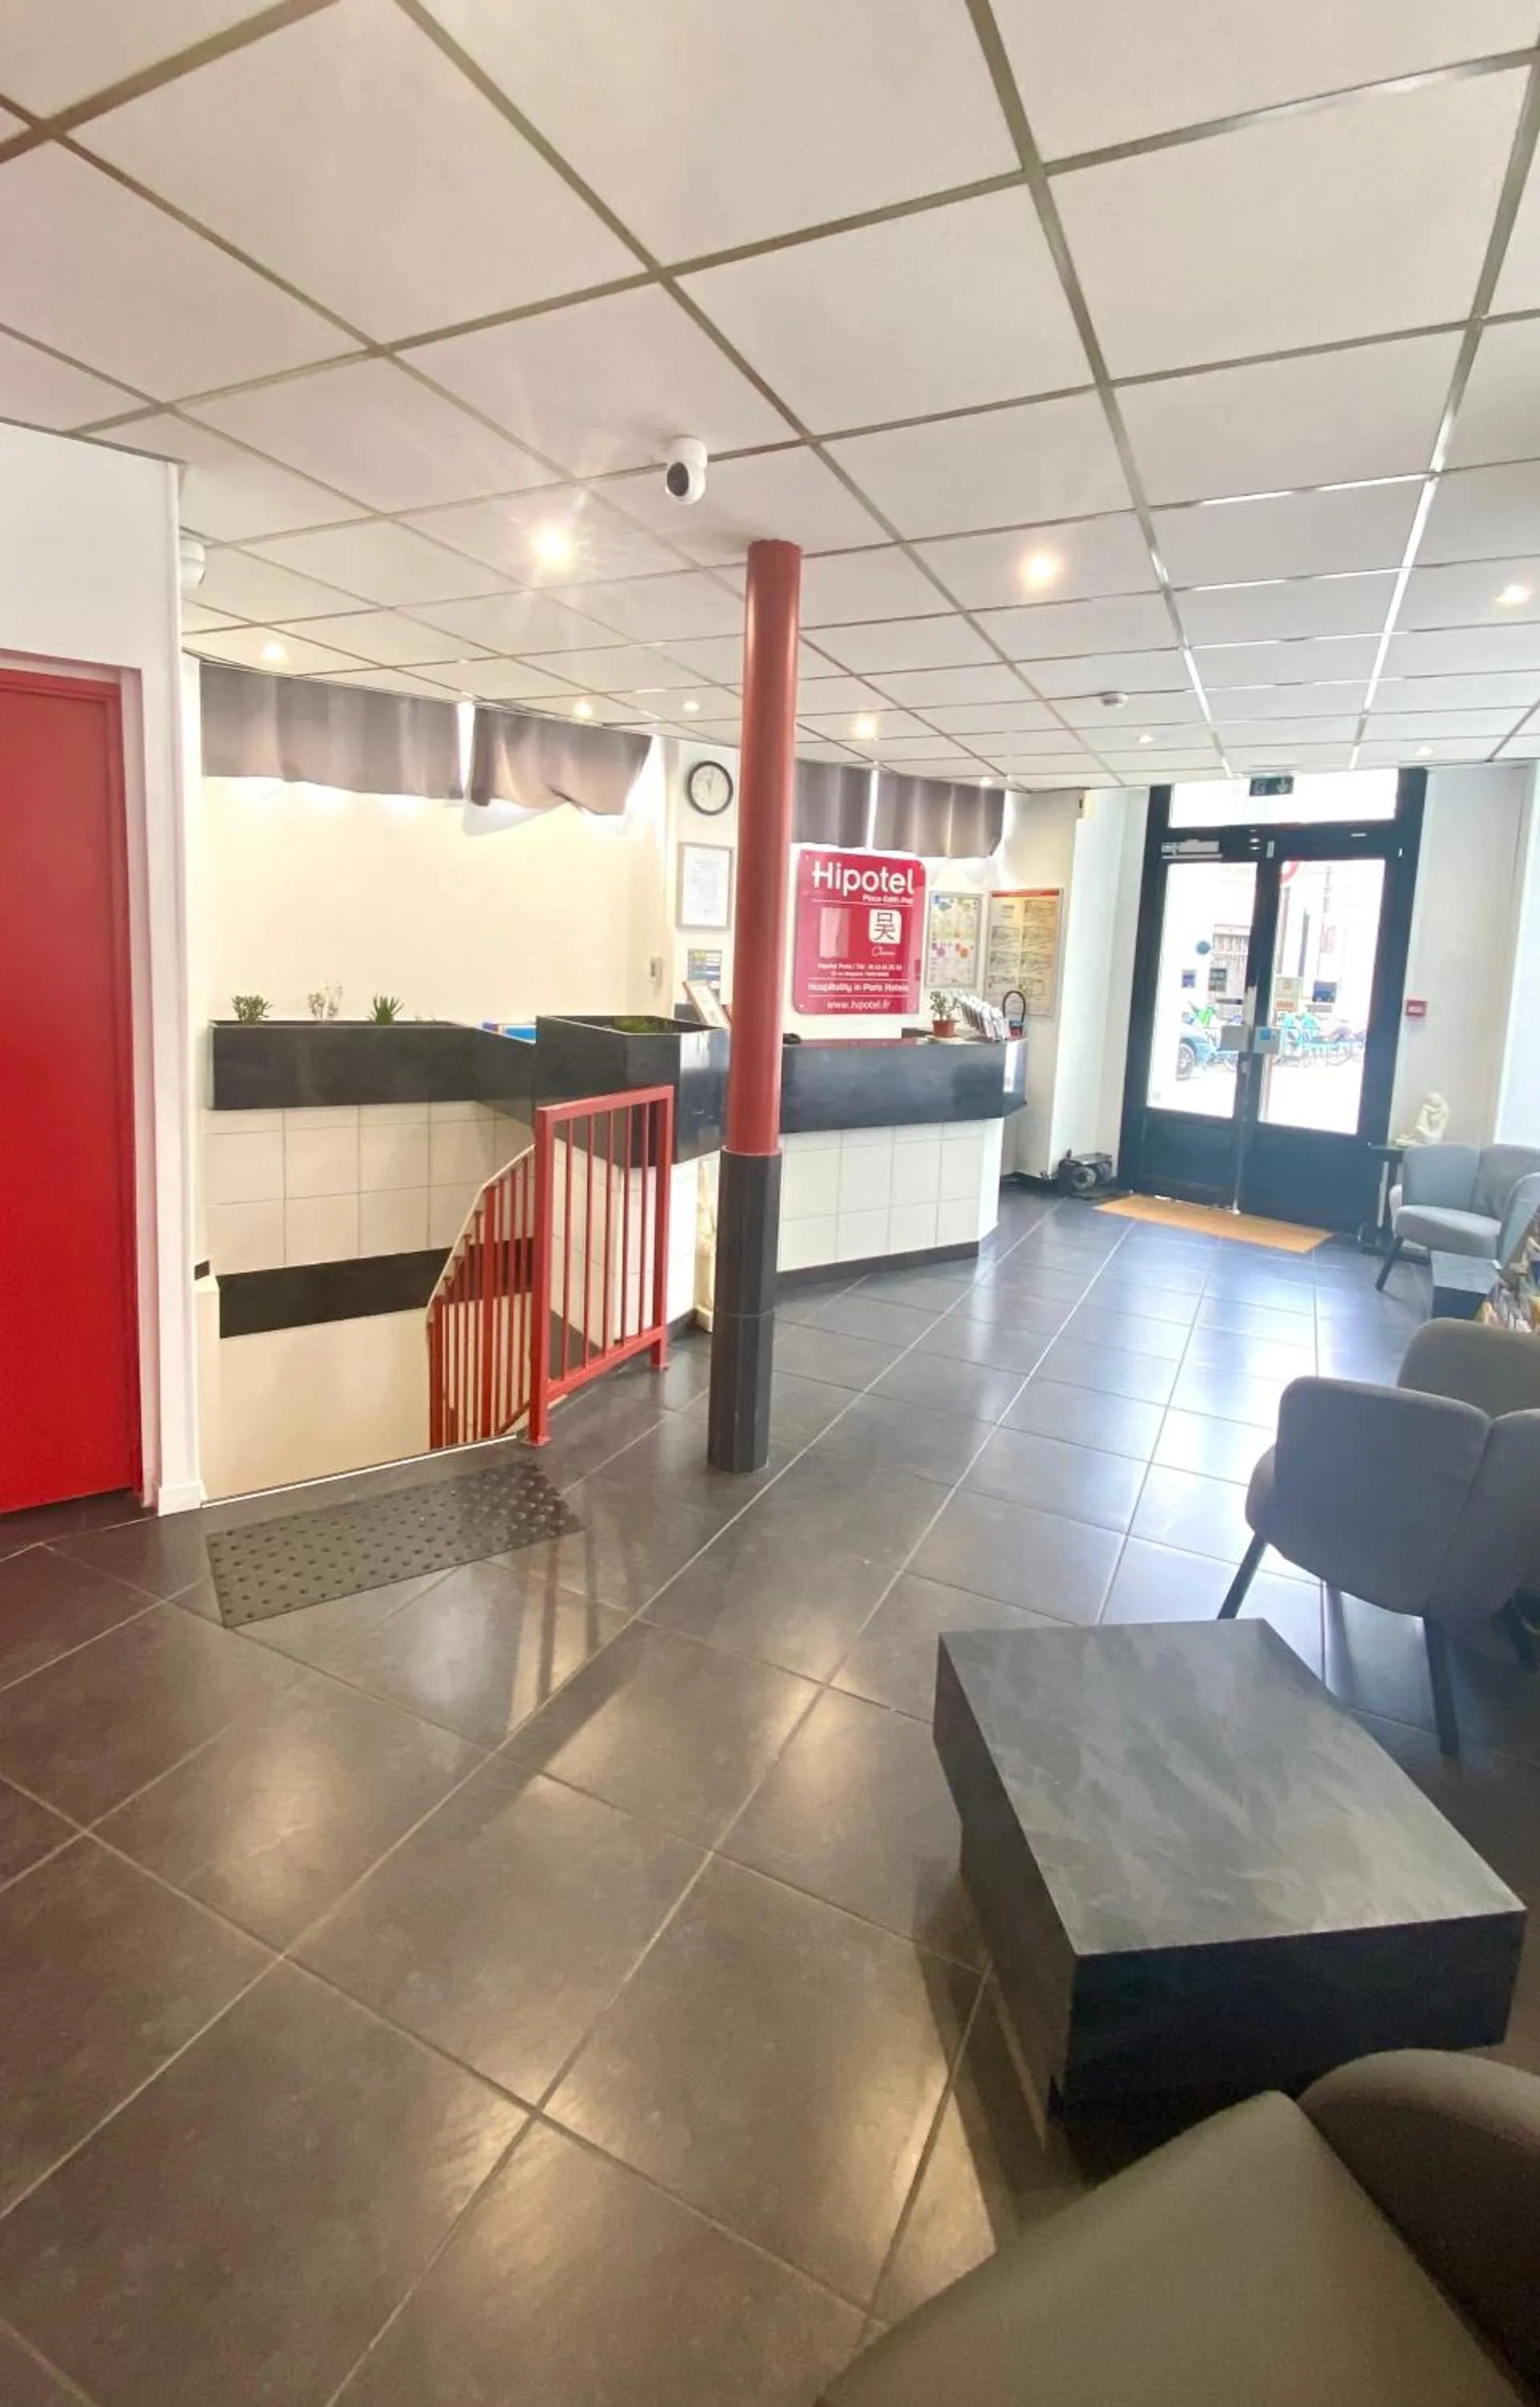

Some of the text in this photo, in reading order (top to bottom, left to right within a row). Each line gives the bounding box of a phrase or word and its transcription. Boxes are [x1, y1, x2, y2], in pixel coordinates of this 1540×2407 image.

[812, 859, 915, 897] Hipotel
[808, 982, 852, 993] Hospitality
[853, 983, 862, 992] in
[863, 983, 883, 992] Paris
[827, 999, 891, 1011] www.hipotel.fr
